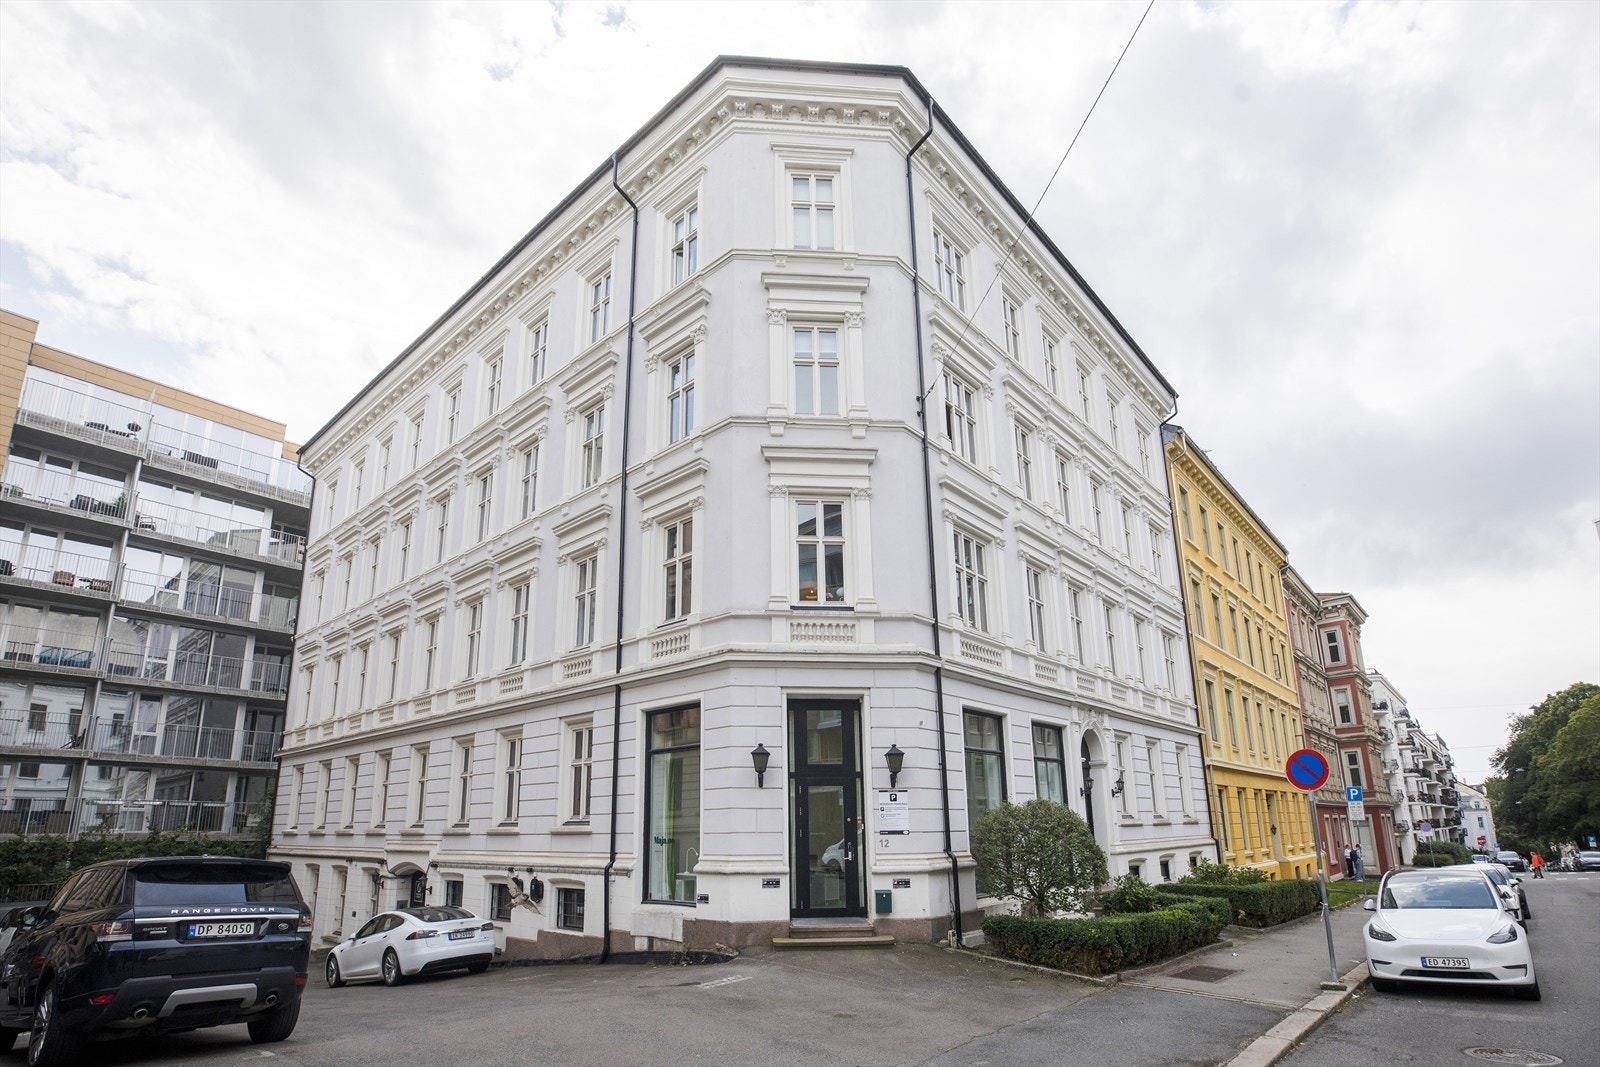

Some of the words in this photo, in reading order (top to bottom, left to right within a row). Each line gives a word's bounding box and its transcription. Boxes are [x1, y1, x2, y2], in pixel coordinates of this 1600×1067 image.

[1349, 789, 1358, 799] P
[879, 839, 890, 848] 12
[197, 925, 213, 935] DP
[217, 923, 252, 934] 84050
[1428, 958, 1439, 966] ED
[1441, 959, 1467, 967] 47395
